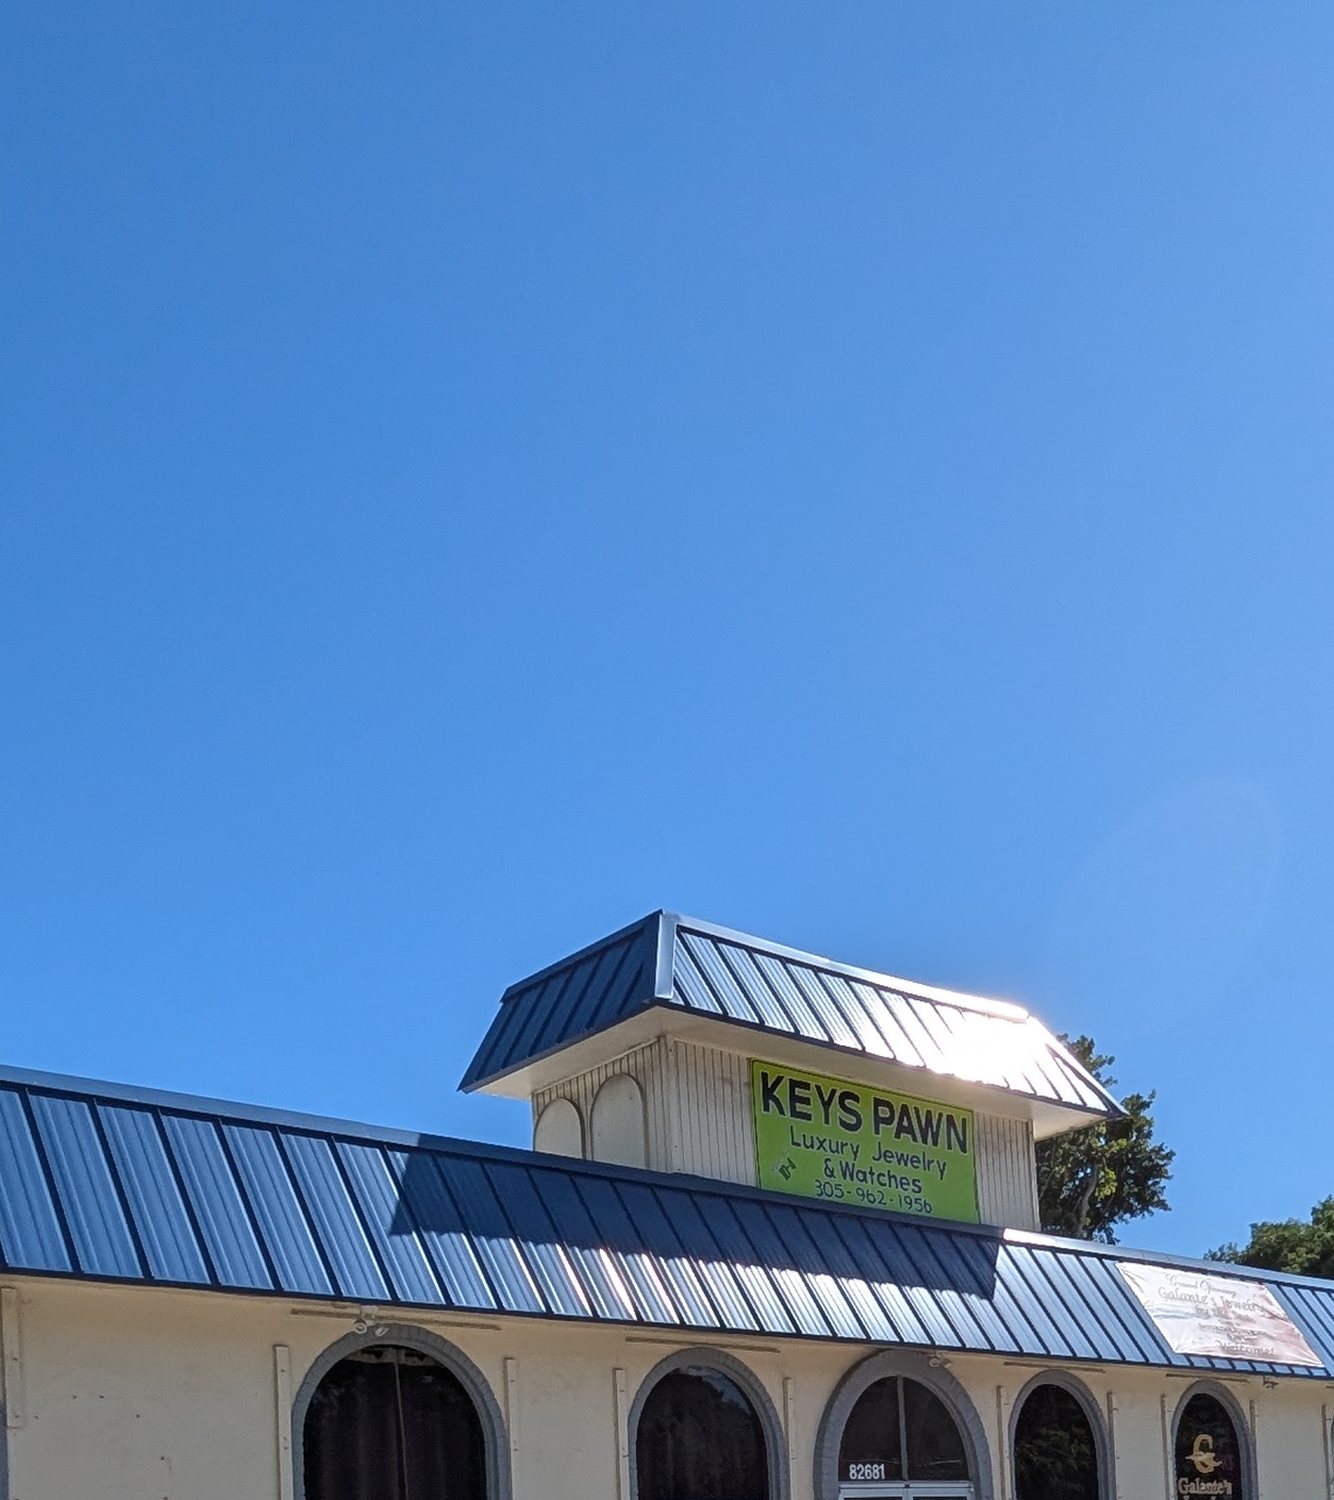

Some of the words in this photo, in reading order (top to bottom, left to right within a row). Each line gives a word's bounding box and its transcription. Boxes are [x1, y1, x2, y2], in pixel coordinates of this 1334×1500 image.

[761, 1071, 863, 1132] KEYS
[873, 1097, 967, 1154] PAWN
[790, 1125, 860, 1161] Luxury
[872, 1141, 947, 1180] Jewelry
[824, 1158, 836, 1179] &
[839, 1160, 923, 1194] Watches
[814, 1179, 933, 1214] 305-962-1956
[849, 1463, 886, 1480] 82681
